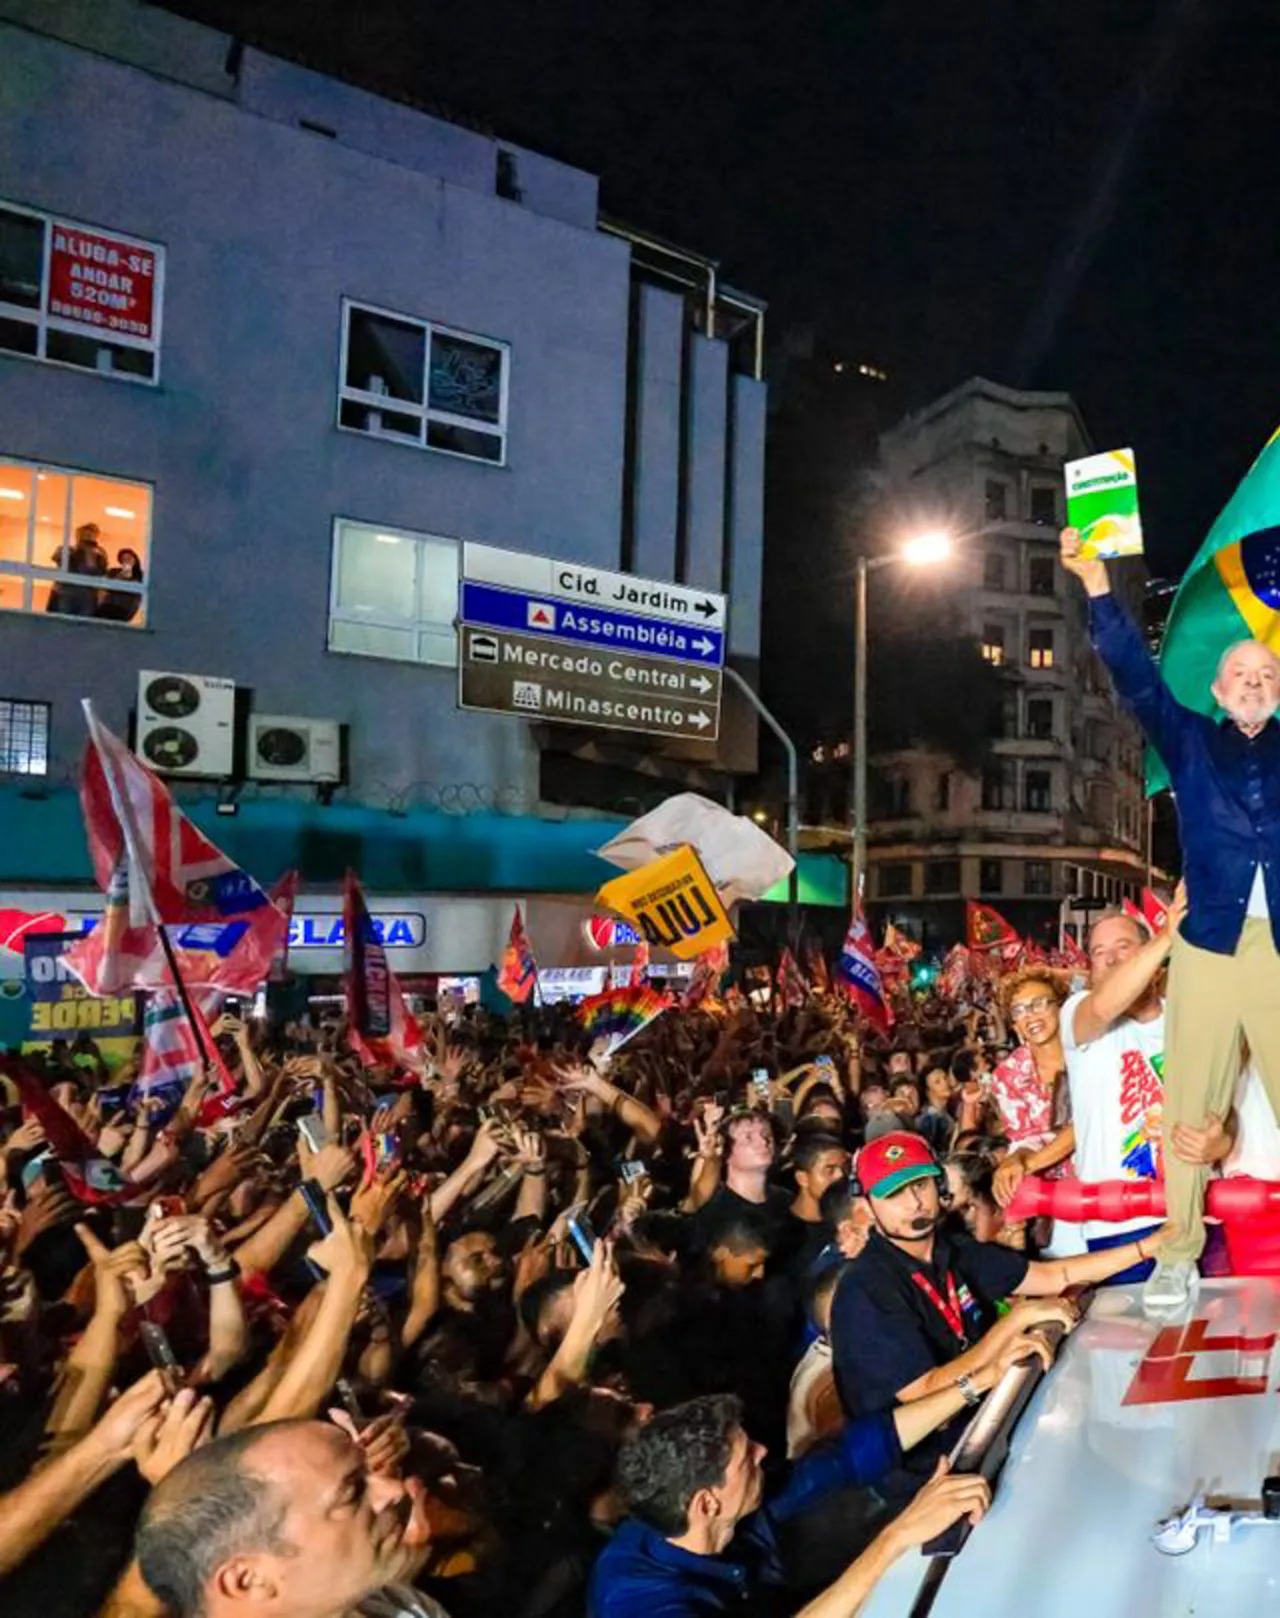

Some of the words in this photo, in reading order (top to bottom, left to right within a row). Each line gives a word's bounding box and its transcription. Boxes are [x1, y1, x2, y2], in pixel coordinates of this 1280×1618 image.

[54, 233, 153, 276] ALUGA-SE
[612, 584, 688, 614] Jardim
[561, 611, 688, 650] Assembléia
[503, 643, 602, 675] Mercado
[608, 662, 686, 690] Central
[546, 690, 684, 724] Minascentro
